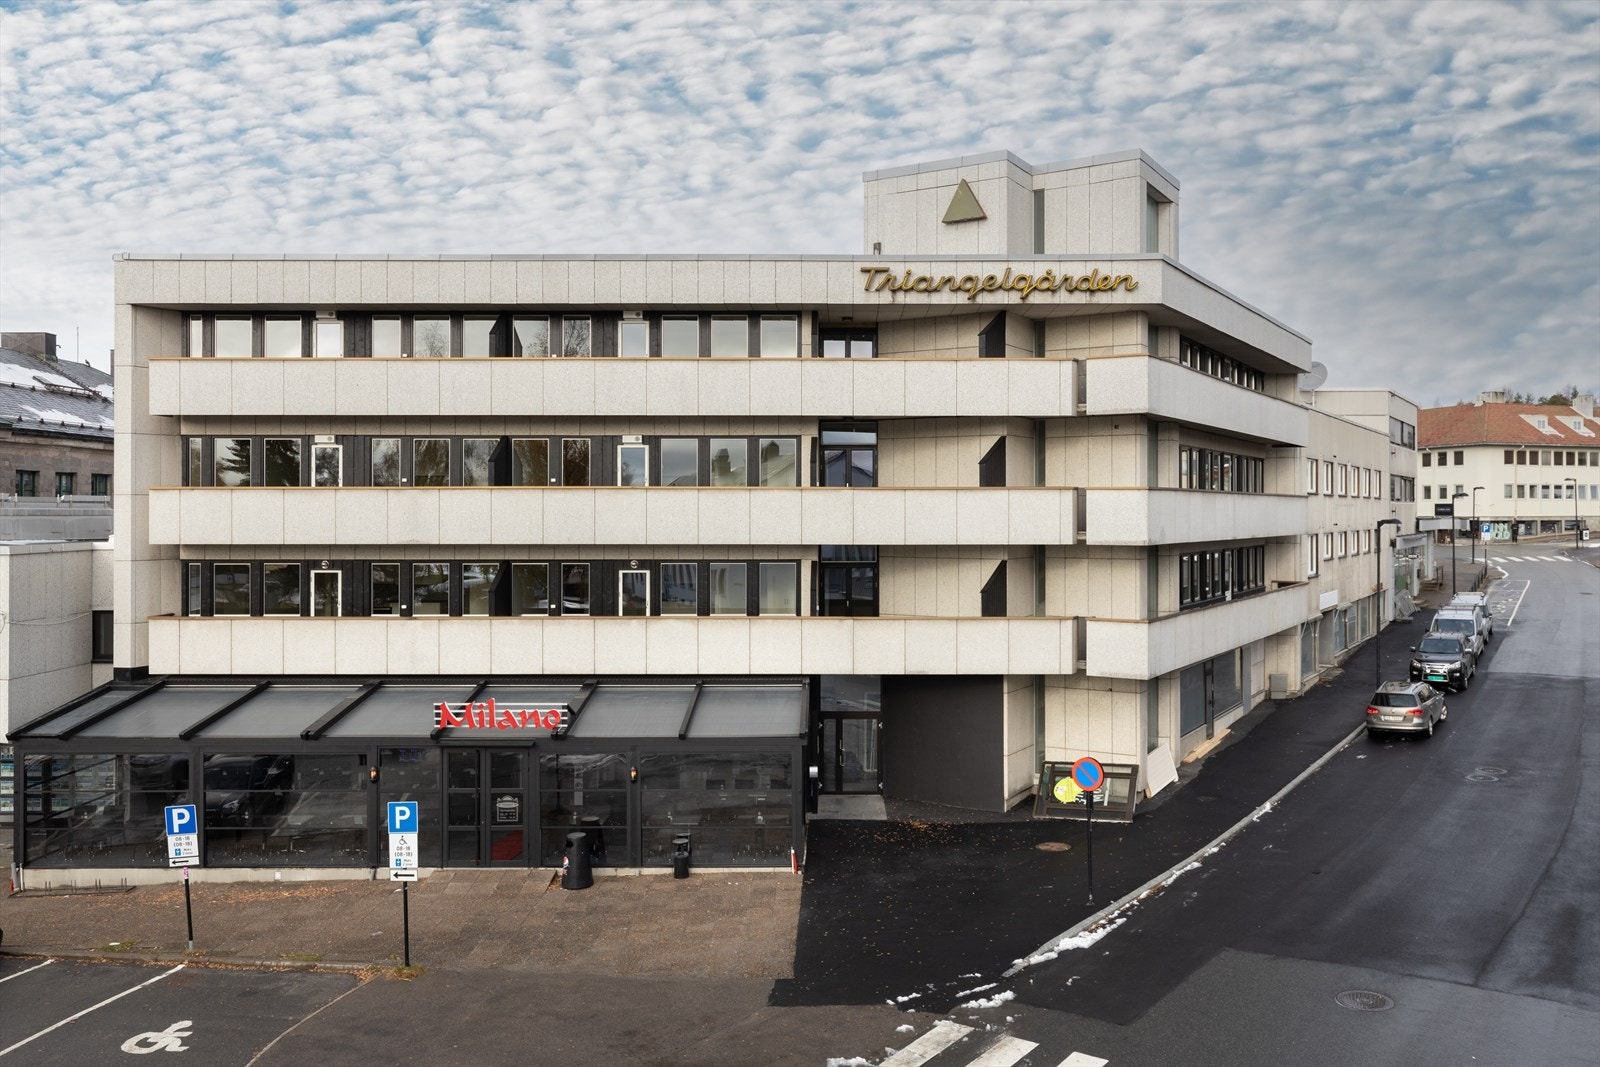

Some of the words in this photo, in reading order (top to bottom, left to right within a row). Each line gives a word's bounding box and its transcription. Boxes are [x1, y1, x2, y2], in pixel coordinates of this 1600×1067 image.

[860, 266, 1139, 300] Triangelgården
[439, 697, 562, 731] Milano
[172, 808, 190, 833] P
[395, 806, 410, 829] P
